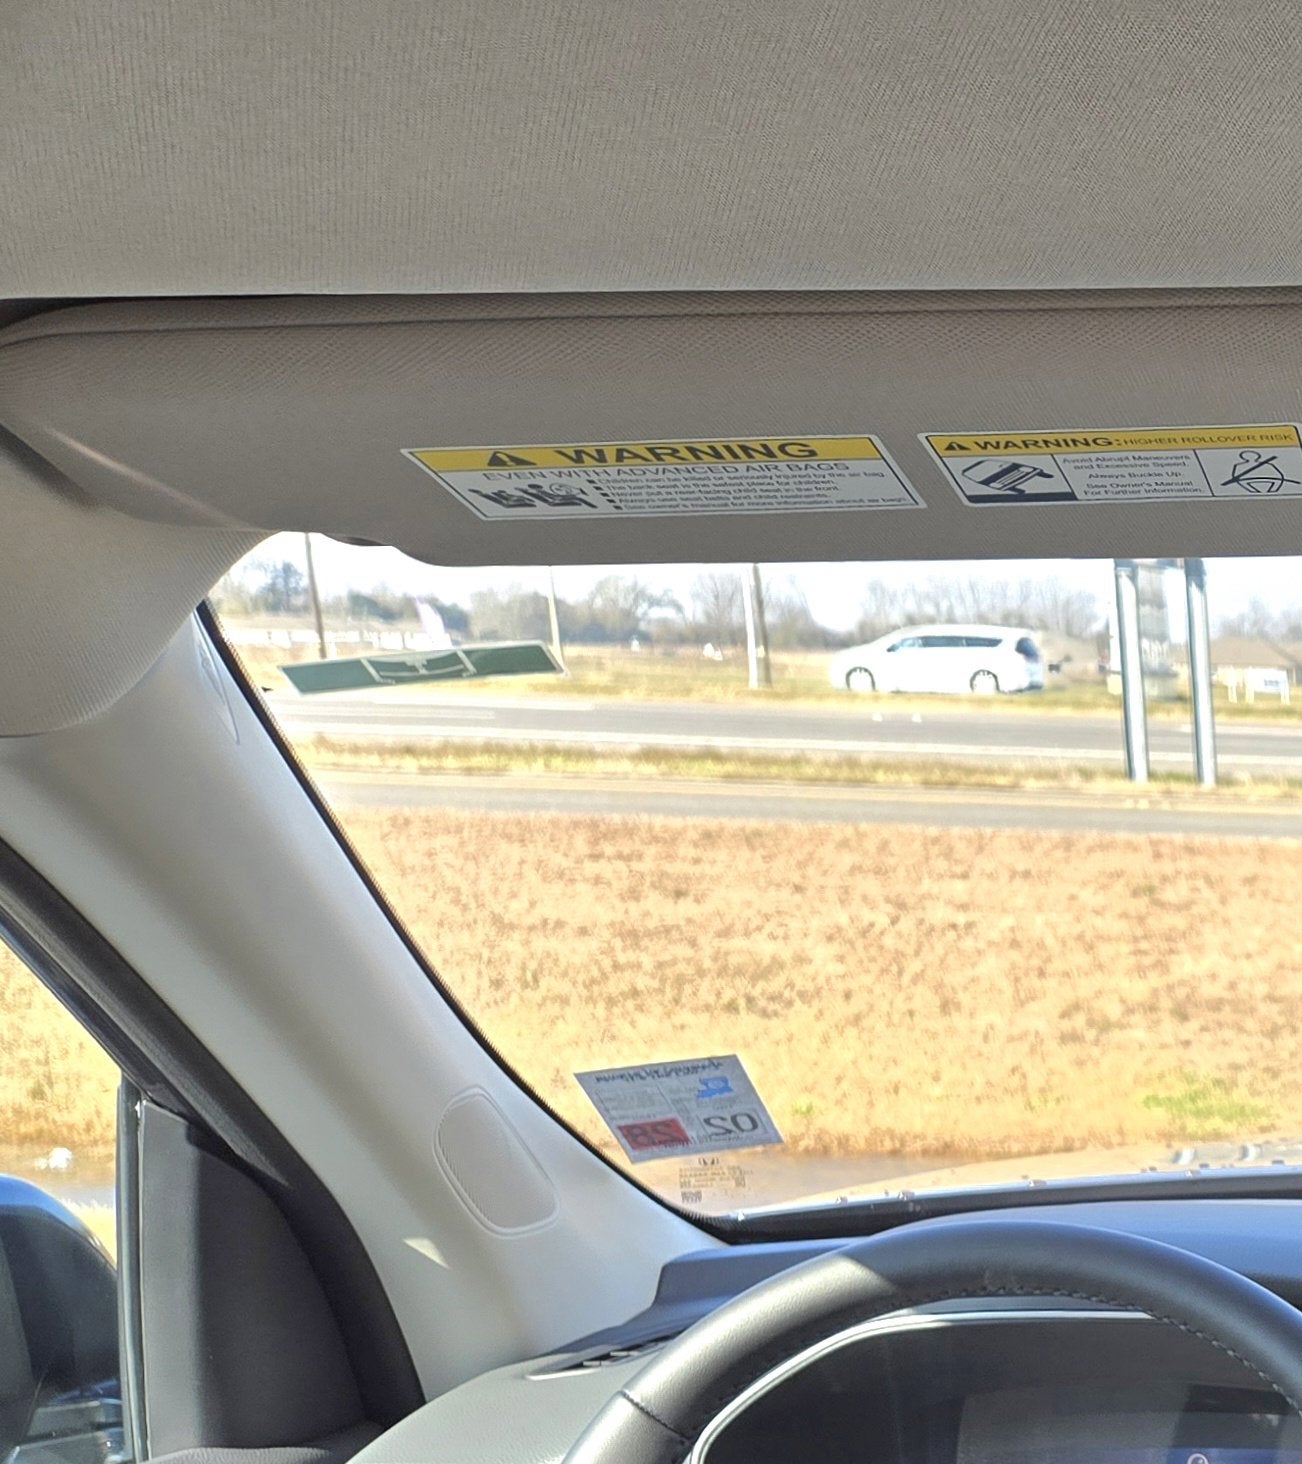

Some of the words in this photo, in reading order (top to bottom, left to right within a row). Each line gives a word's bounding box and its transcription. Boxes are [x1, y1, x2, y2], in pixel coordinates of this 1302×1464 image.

[973, 437, 1121, 451] WARNING:
[1123, 437, 1178, 446] HIGHER
[1180, 434, 1255, 444] ROLLOVER
[1258, 432, 1293, 442] RISK
[554, 442, 818, 464] WARNING
[483, 471, 544, 481] EVEN
[549, 469, 611, 478] WITH
[616, 465, 739, 477] ADVANCED
[745, 464, 783, 472] AIR
[787, 462, 850, 472] BAGS
